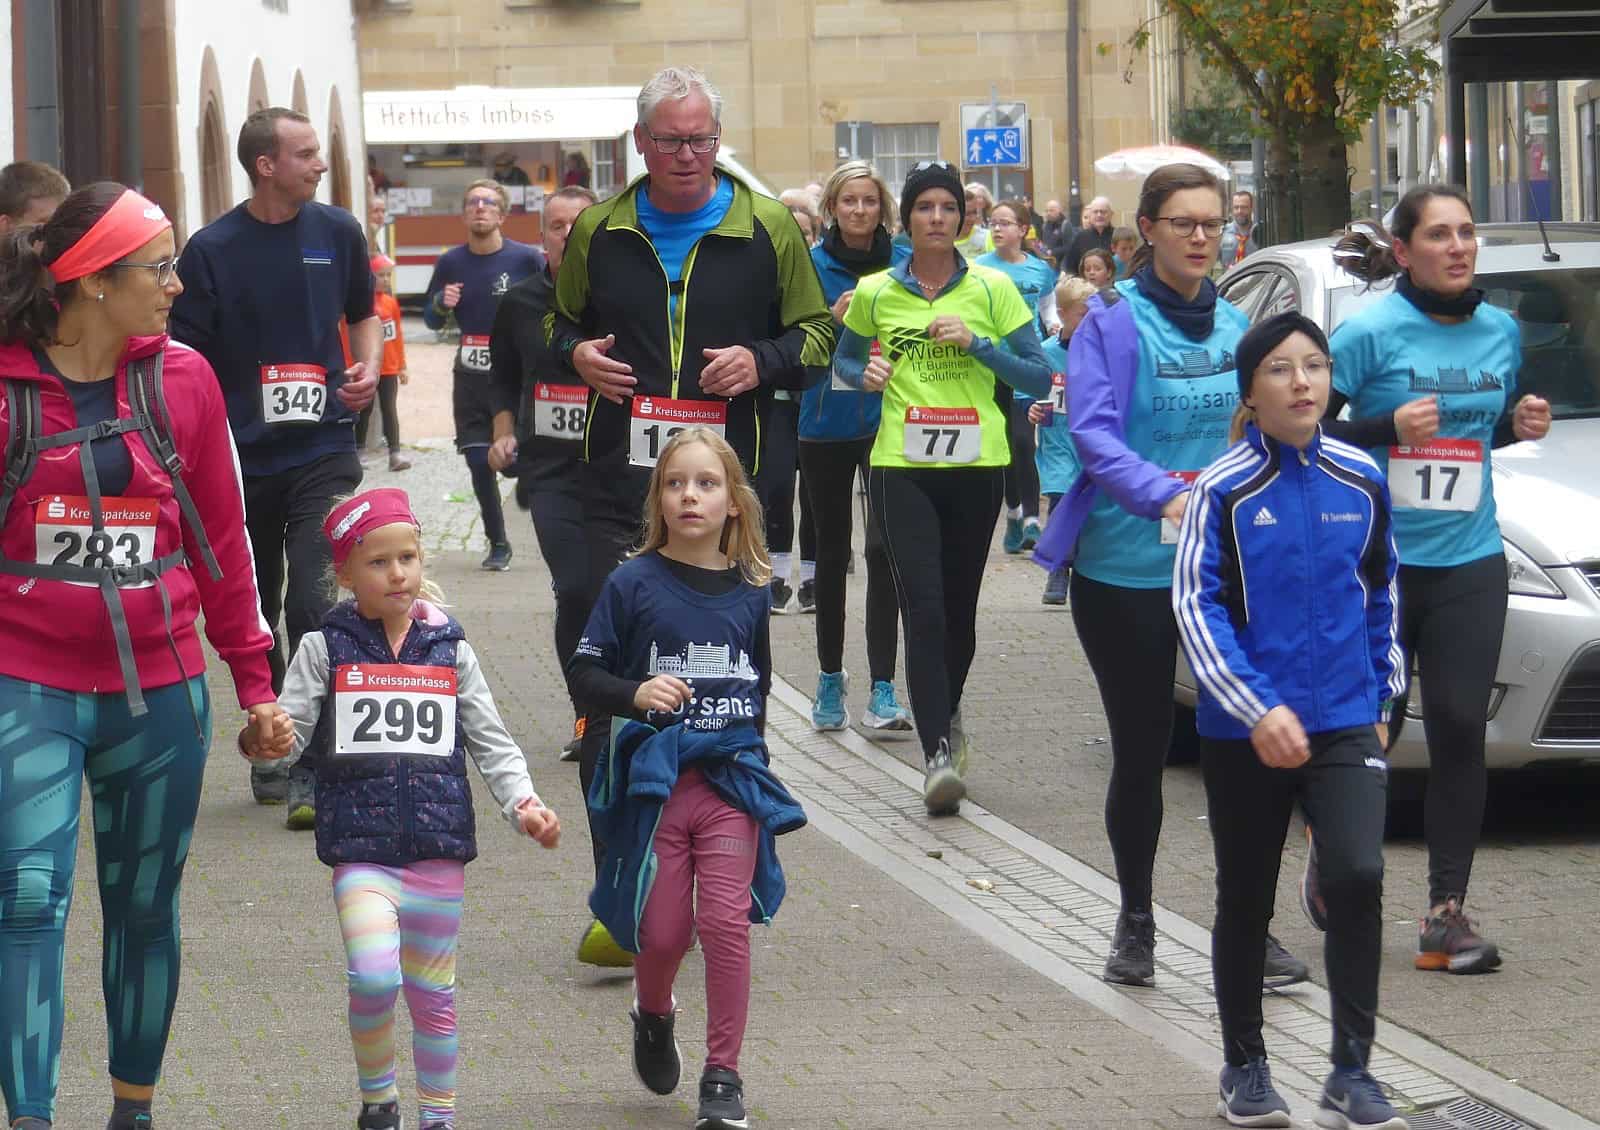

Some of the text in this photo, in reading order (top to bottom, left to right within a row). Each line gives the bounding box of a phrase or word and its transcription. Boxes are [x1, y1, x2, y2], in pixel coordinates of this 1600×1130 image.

[380, 100, 470, 126] Hettichs
[272, 386, 322, 416] 342
[655, 406, 721, 421] Kreissparkasse
[921, 428, 962, 457] 77
[1415, 464, 1461, 501] 17
[53, 531, 142, 569] 283
[368, 674, 450, 689] Kreissparkasse
[352, 698, 443, 744] 299
